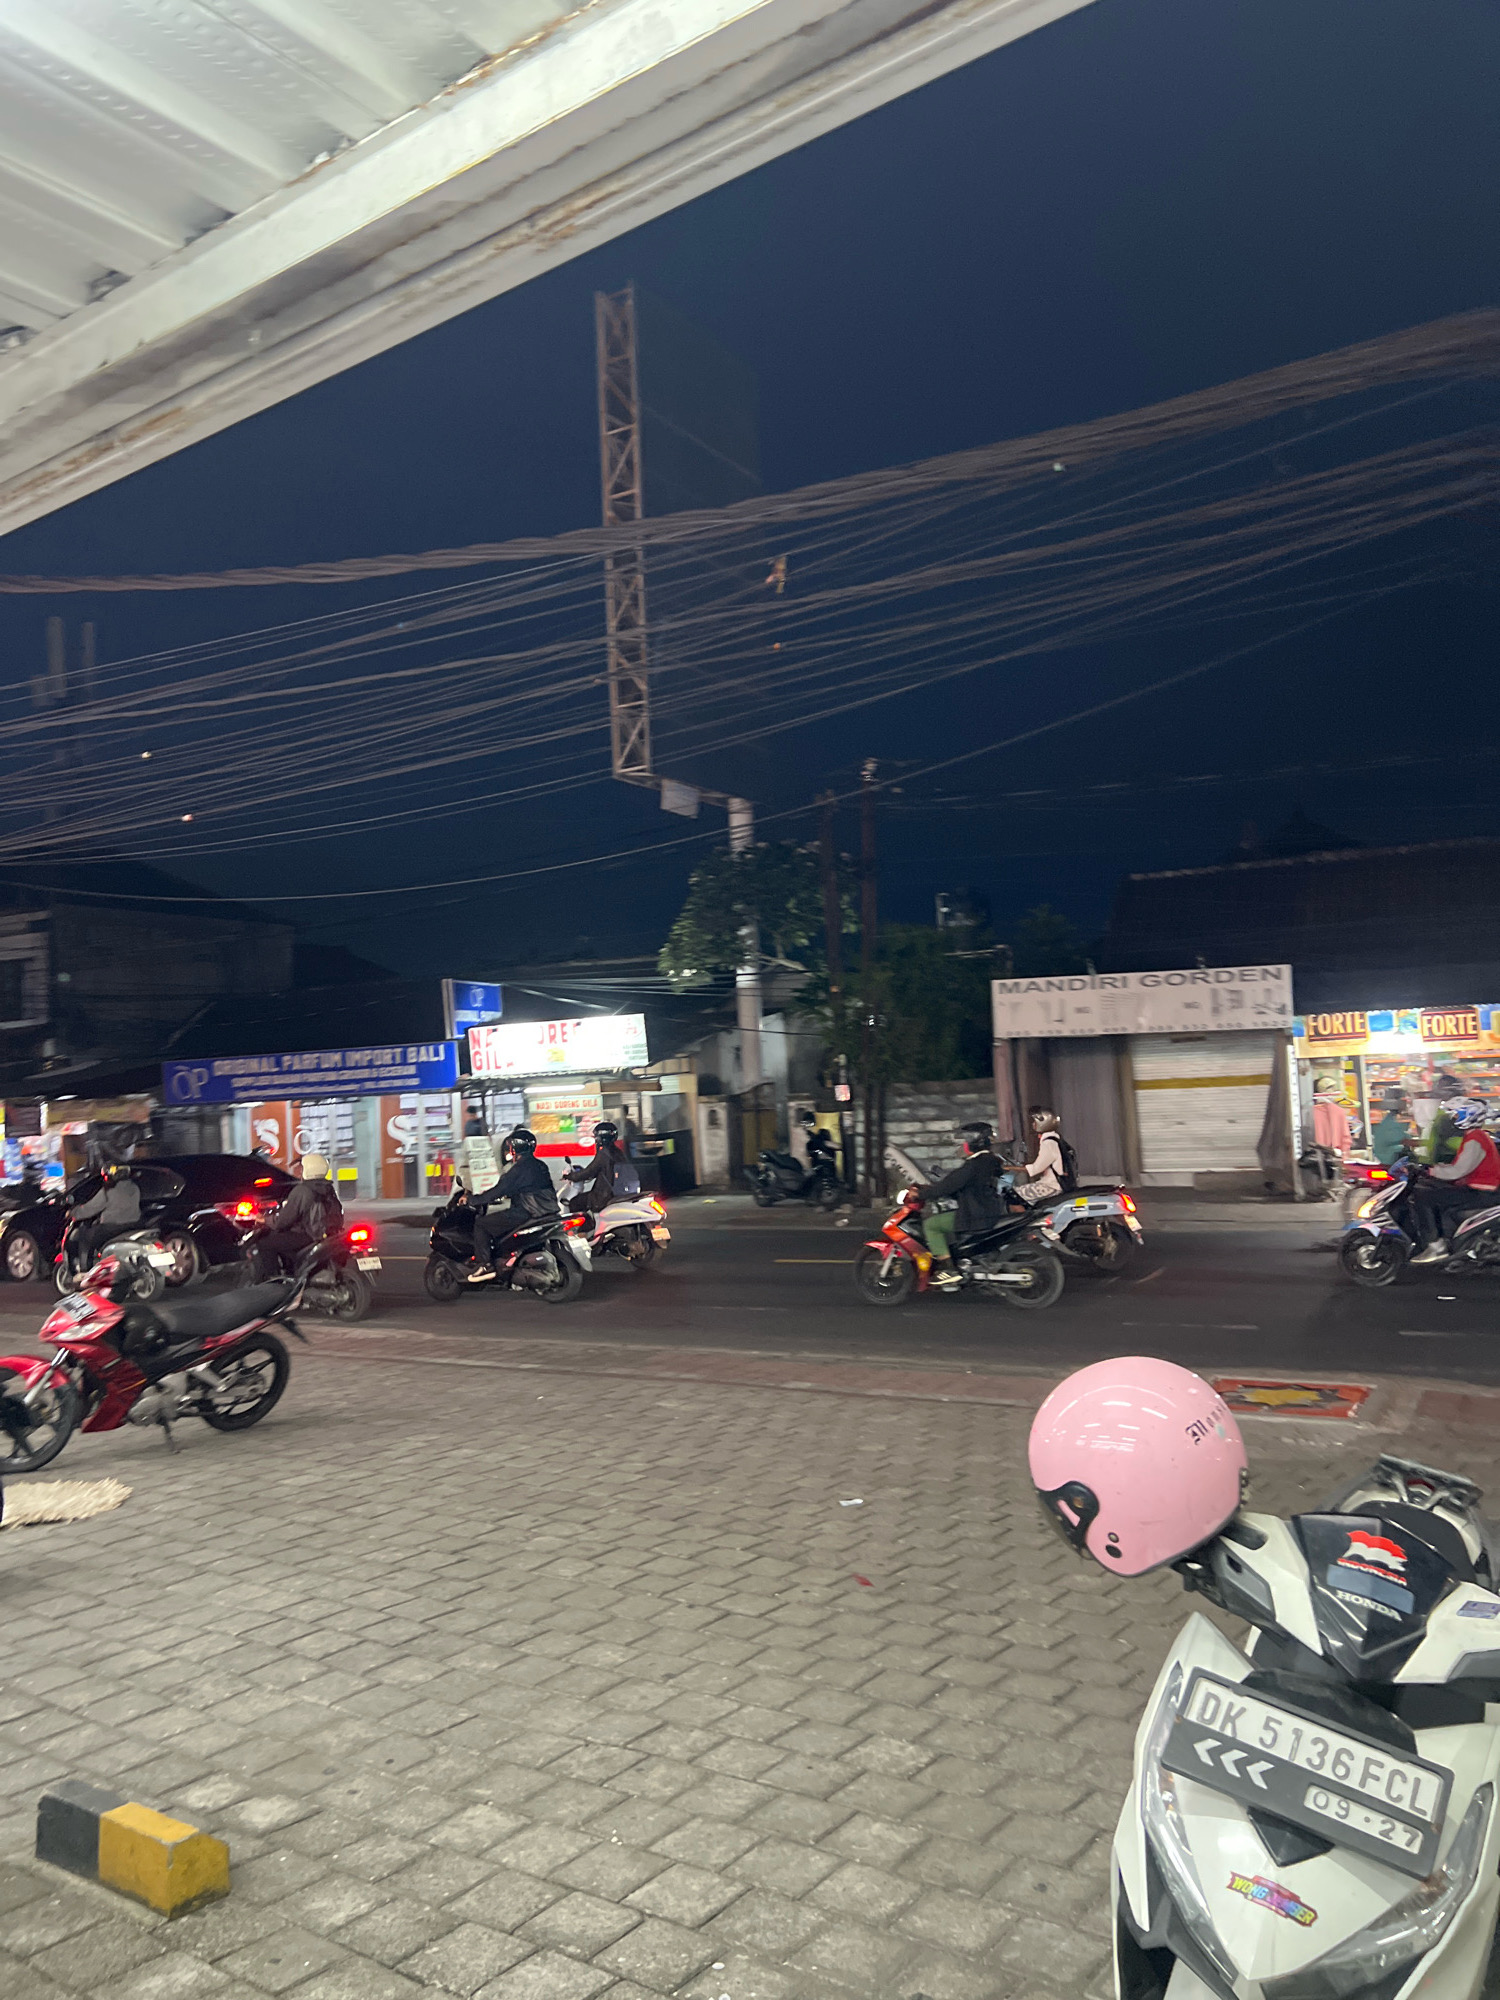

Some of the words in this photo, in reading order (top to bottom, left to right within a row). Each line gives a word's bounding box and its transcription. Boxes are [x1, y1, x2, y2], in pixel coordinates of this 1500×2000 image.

[999, 975, 1129, 995] MANDIRI
[1138, 967, 1283, 988] GORDEN
[1308, 1012, 1367, 1036] FORTE
[1422, 1013, 1478, 1037] FORTE
[282, 1051, 342, 1070] PARFUM
[345, 1047, 402, 1066] IMPORT
[406, 1043, 445, 1063] BALI
[1336, 1589, 1403, 1622] HONDA
[1199, 1692, 1247, 1738] DK
[1231, 1876, 1270, 1900] WONG
